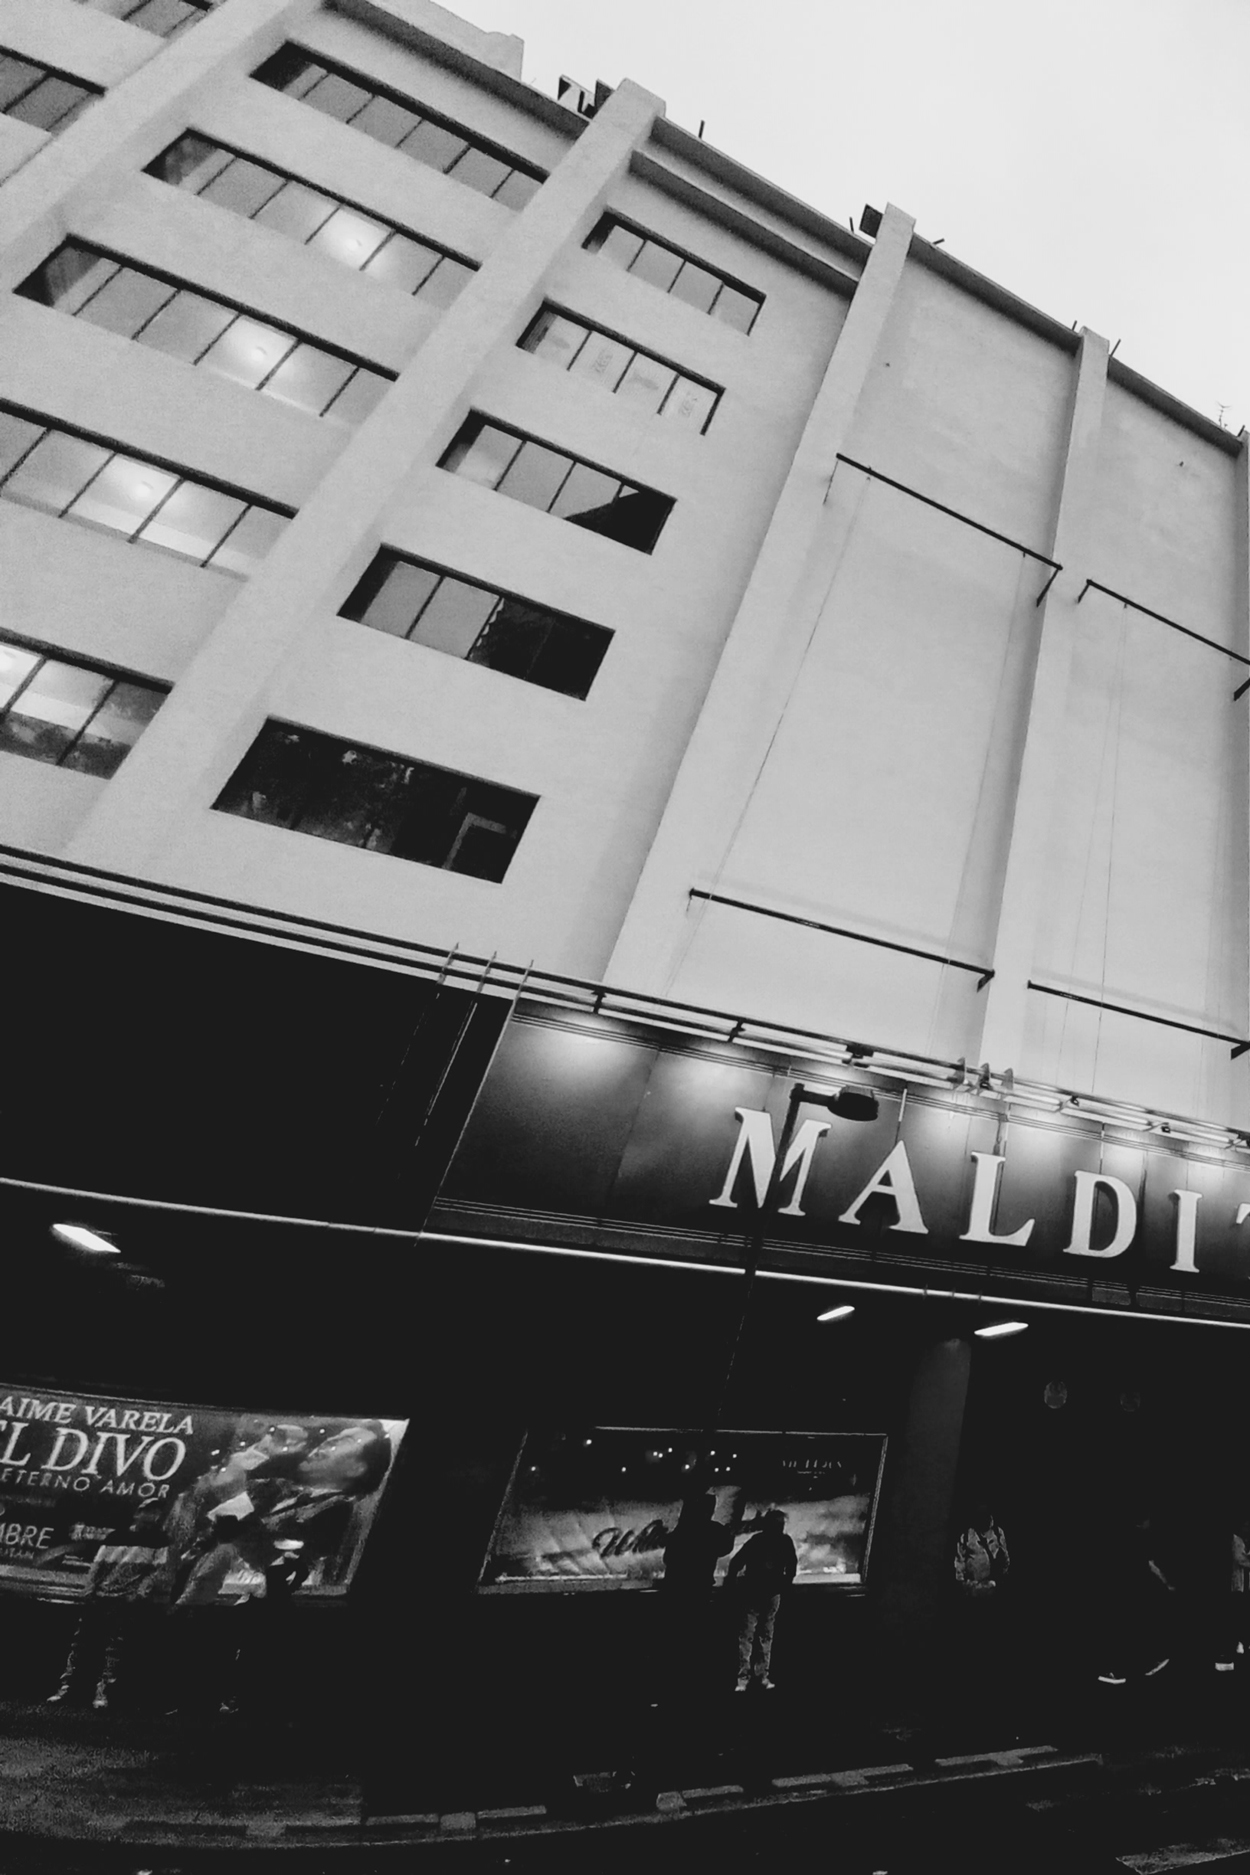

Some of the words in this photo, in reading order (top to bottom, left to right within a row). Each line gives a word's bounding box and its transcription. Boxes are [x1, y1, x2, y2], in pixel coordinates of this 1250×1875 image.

[84, 1406, 193, 1434] VARELA
[40, 1427, 186, 1480] DIVO
[1, 1468, 91, 1491] ETERNO
[100, 1479, 170, 1498] AMOR
